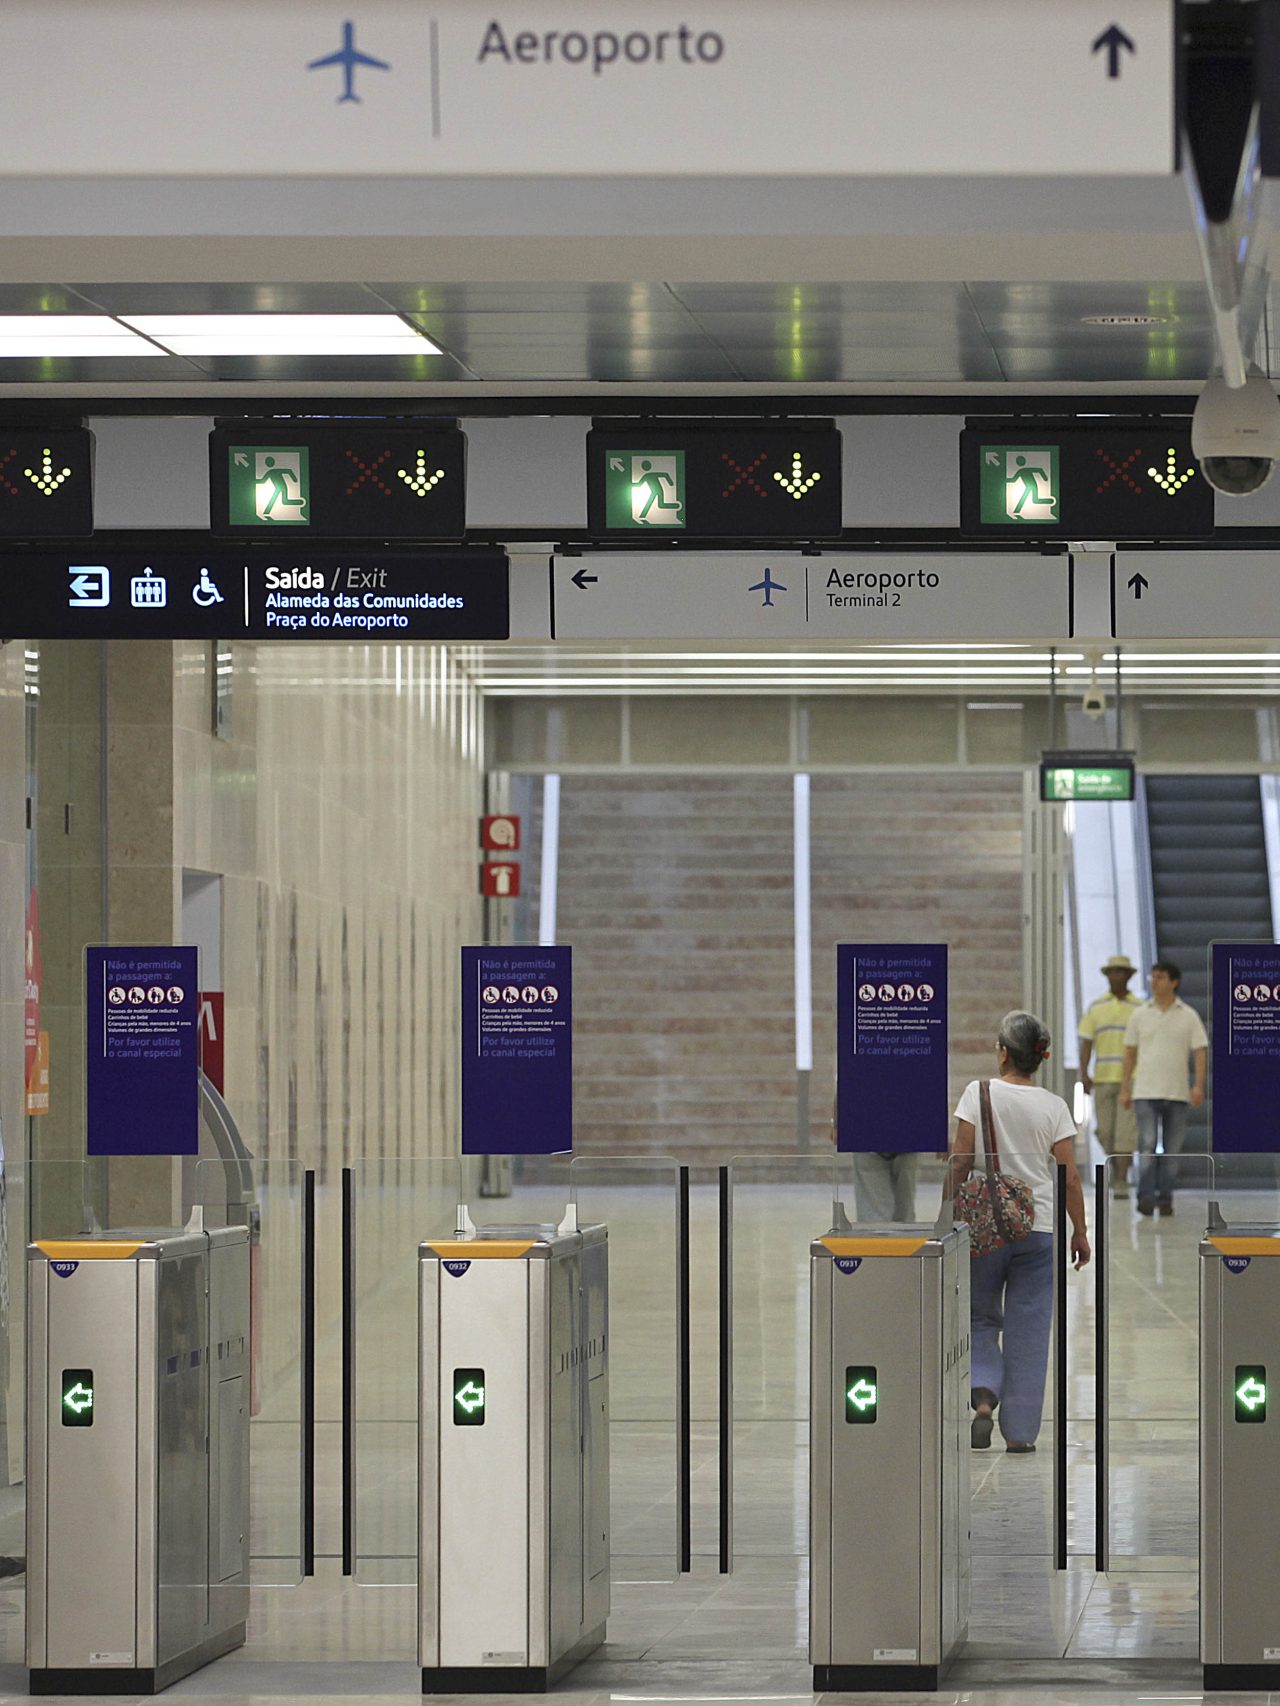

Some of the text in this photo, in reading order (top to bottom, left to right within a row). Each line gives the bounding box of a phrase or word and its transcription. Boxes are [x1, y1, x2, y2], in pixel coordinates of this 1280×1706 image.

[477, 19, 725, 76] Aeroporto
[265, 566, 388, 591] Saída / Exit
[826, 568, 940, 592] Aeroporto
[265, 592, 464, 610] Alameda das Comunidades
[826, 592, 901, 607] Terminal 2
[266, 611, 409, 631] Praça do Aeroporto
[108, 961, 181, 970] Não é permitida
[482, 960, 555, 970] Não é permitida
[858, 958, 931, 967] Não é permitida
[116, 974, 162, 982] passagem
[490, 973, 536, 981] passagem
[866, 971, 912, 979] passagem
[108, 1037, 180, 1046] Por favor utilize
[483, 1037, 554, 1045] Por favor utilize
[858, 1035, 930, 1043] Por favor utilize
[117, 1049, 141, 1057] canal
[144, 1049, 181, 1059] especial
[491, 1048, 515, 1057] canal
[518, 1048, 555, 1058] especial
[867, 1046, 891, 1055] canal
[894, 1046, 931, 1056] especial
[56, 1263, 75, 1271] 0933
[448, 1263, 467, 1271] 0932
[839, 1260, 858, 1268] 0931
[1228, 1259, 1248, 1267] 0930
